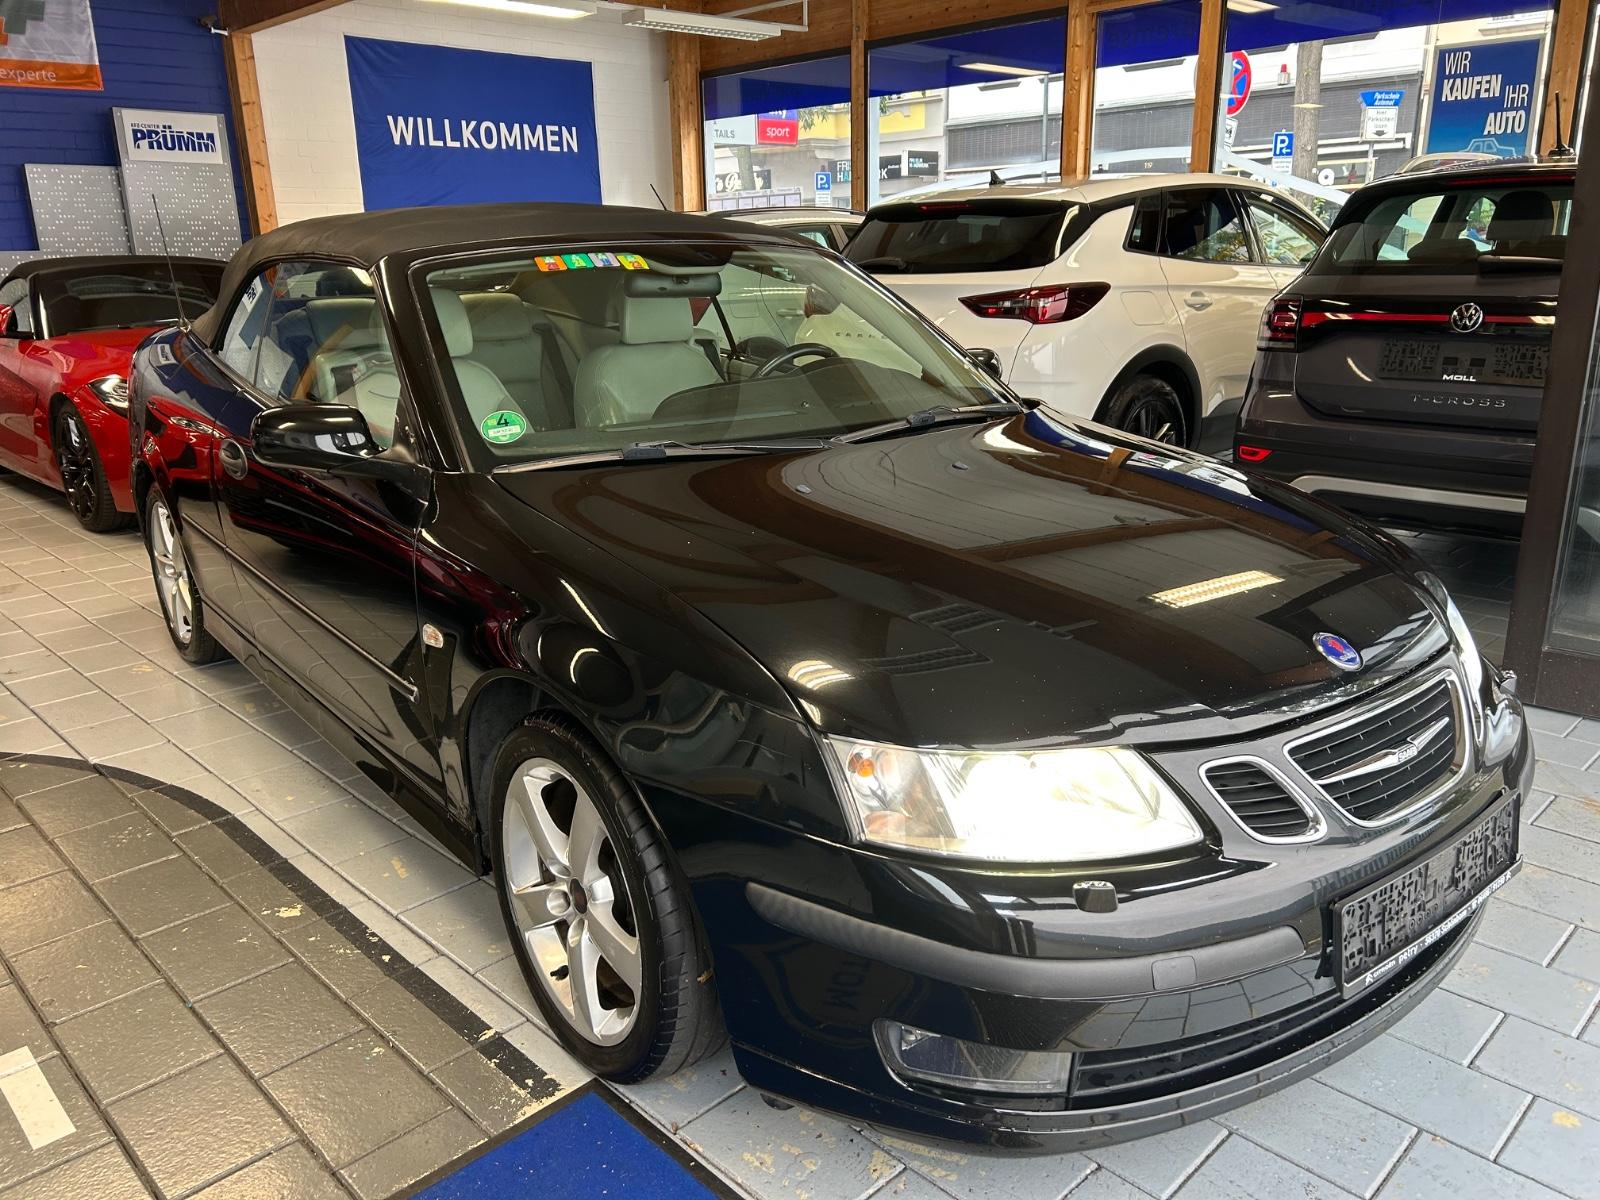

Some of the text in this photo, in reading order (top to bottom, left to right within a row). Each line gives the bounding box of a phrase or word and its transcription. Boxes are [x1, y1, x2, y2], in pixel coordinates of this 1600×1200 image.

[1445, 50, 1472, 76] WIR
[1441, 74, 1502, 102] KAUFEN
[1503, 83, 1530, 109] IHR
[386, 114, 579, 153] WILLKOMMEN
[766, 126, 790, 138] sport
[1483, 109, 1526, 136] AUTO
[131, 125, 217, 153] PRÜMM
[1442, 374, 1477, 382] MOLL
[496, 413, 510, 427] 4
